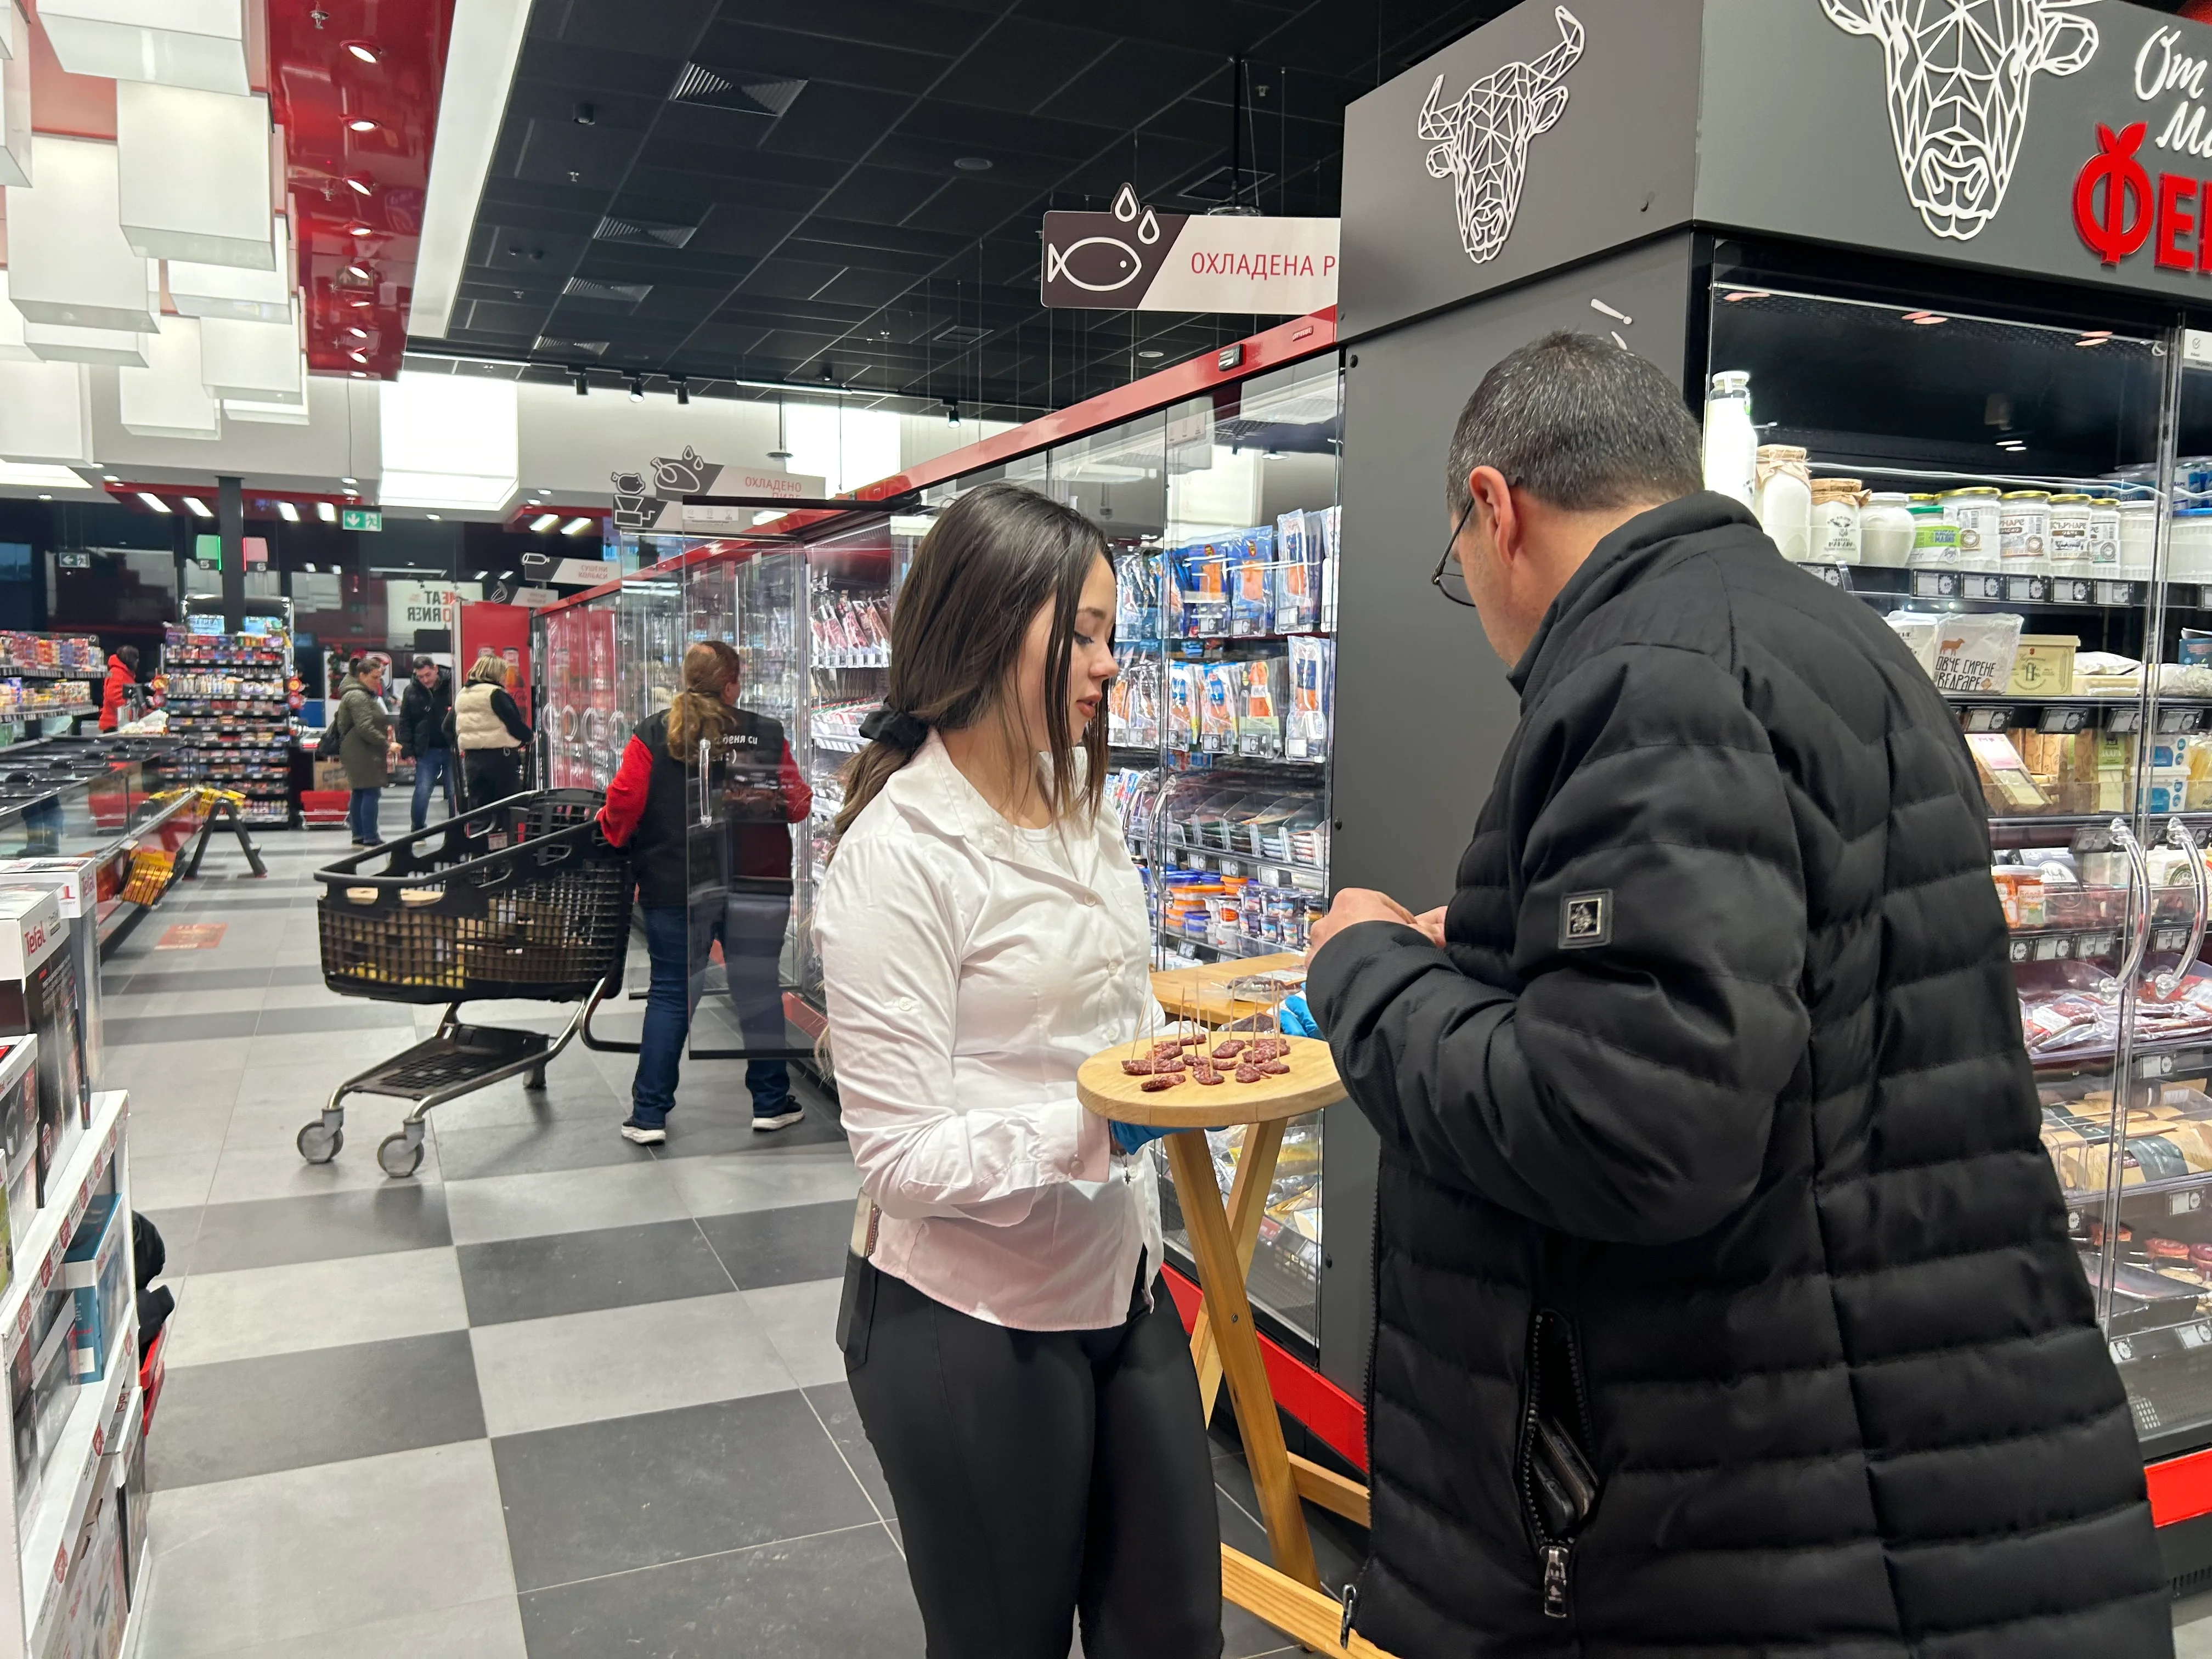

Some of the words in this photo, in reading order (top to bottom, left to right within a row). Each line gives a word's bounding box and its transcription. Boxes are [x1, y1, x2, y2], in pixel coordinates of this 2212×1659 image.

[1190, 252, 1314, 280] ОХЛАДЕНА
[1323, 254, 1336, 276] Р
[745, 476, 802, 493] ОХЛАДЕНО
[200, 560, 210, 569] 5
[1935, 656, 1961, 673] ОВЧЕ
[1962, 659, 1996, 678] СИРЕНЕ
[723, 733, 746, 744] деня
[748, 736, 758, 744] си
[24, 921, 46, 957] Tefal
